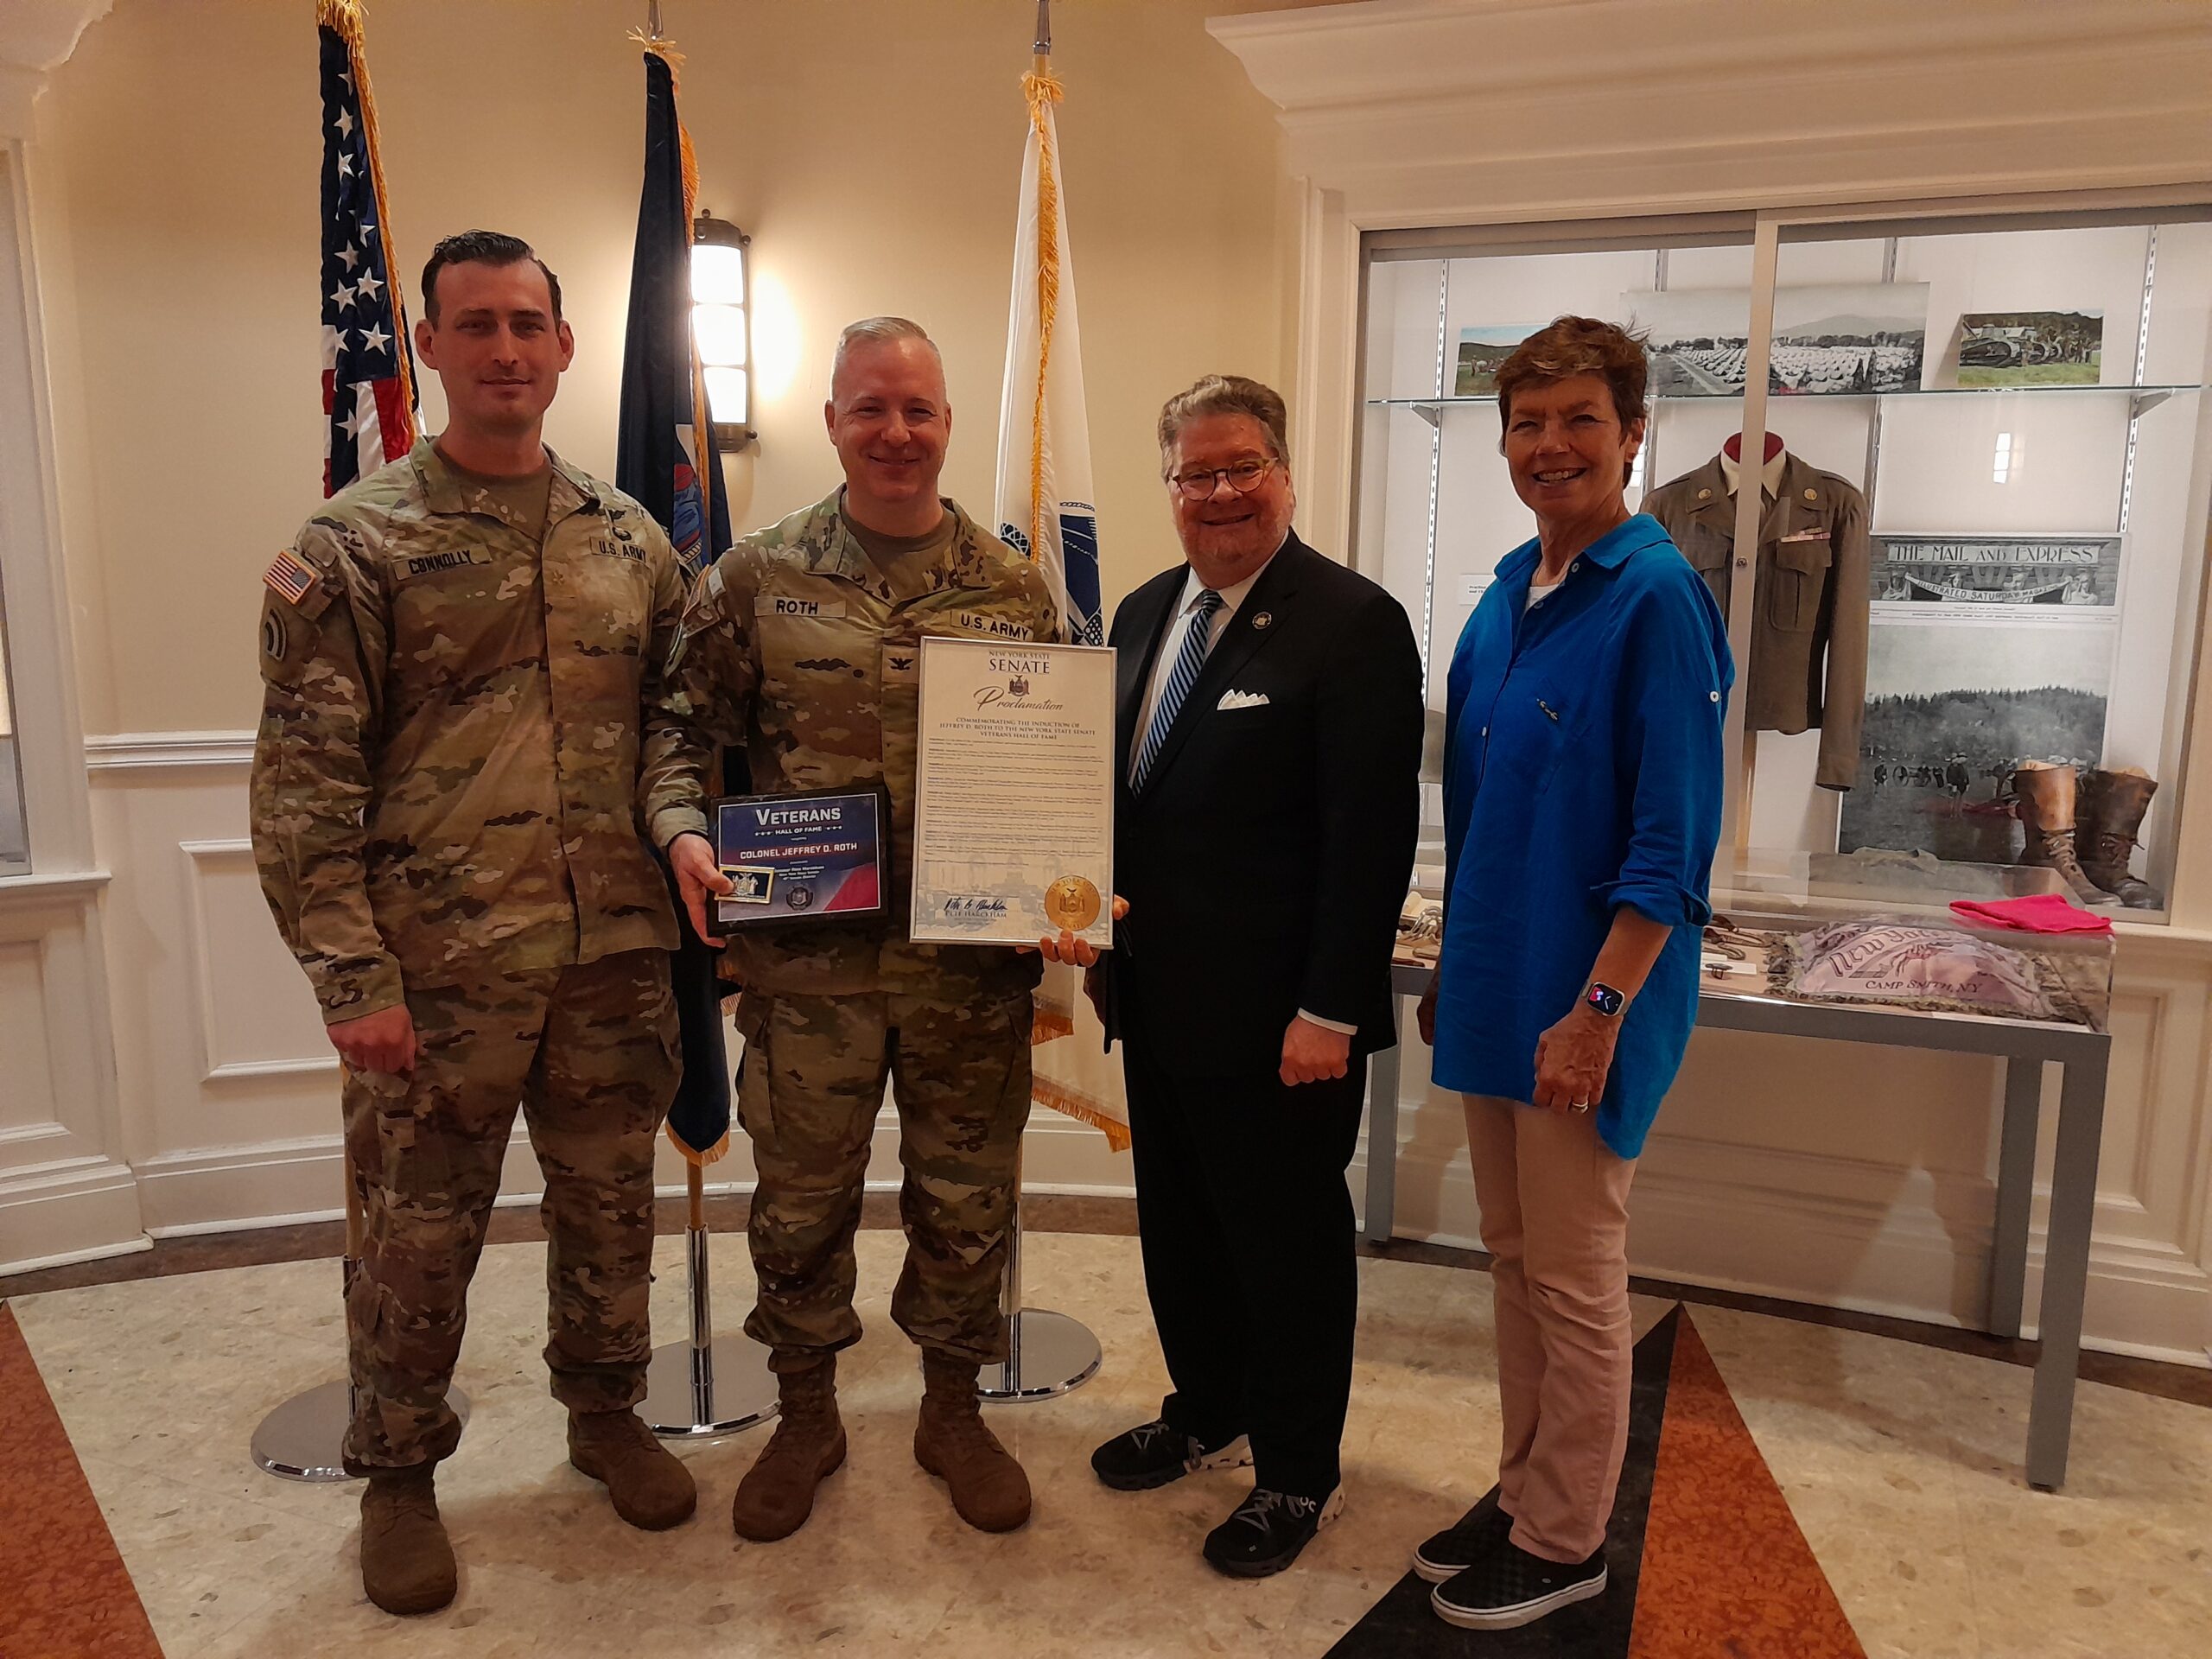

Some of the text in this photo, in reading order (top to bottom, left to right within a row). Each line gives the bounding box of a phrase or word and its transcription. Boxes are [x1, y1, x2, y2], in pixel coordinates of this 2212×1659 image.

[599, 541, 620, 556] U.S.
[1895, 544, 2094, 563] THE MAIL AND EXPRESS
[408, 550, 473, 575] CONNOLLY
[1917, 580, 1967, 599] ILLUSTRATED
[1971, 591, 2019, 601] SATURDAY
[776, 599, 819, 615] ROTH
[960, 613, 1030, 641] U.S. ARMY
[988, 658, 1051, 674] SENATE
[973, 685, 1064, 711] Proclamation
[756, 807, 842, 826] VETERANS
[740, 842, 858, 861] COLONEL JEFFREY D. ROTH
[1827, 938, 1885, 977] New
[1865, 980, 1983, 994] CAMP SMITH, NY
